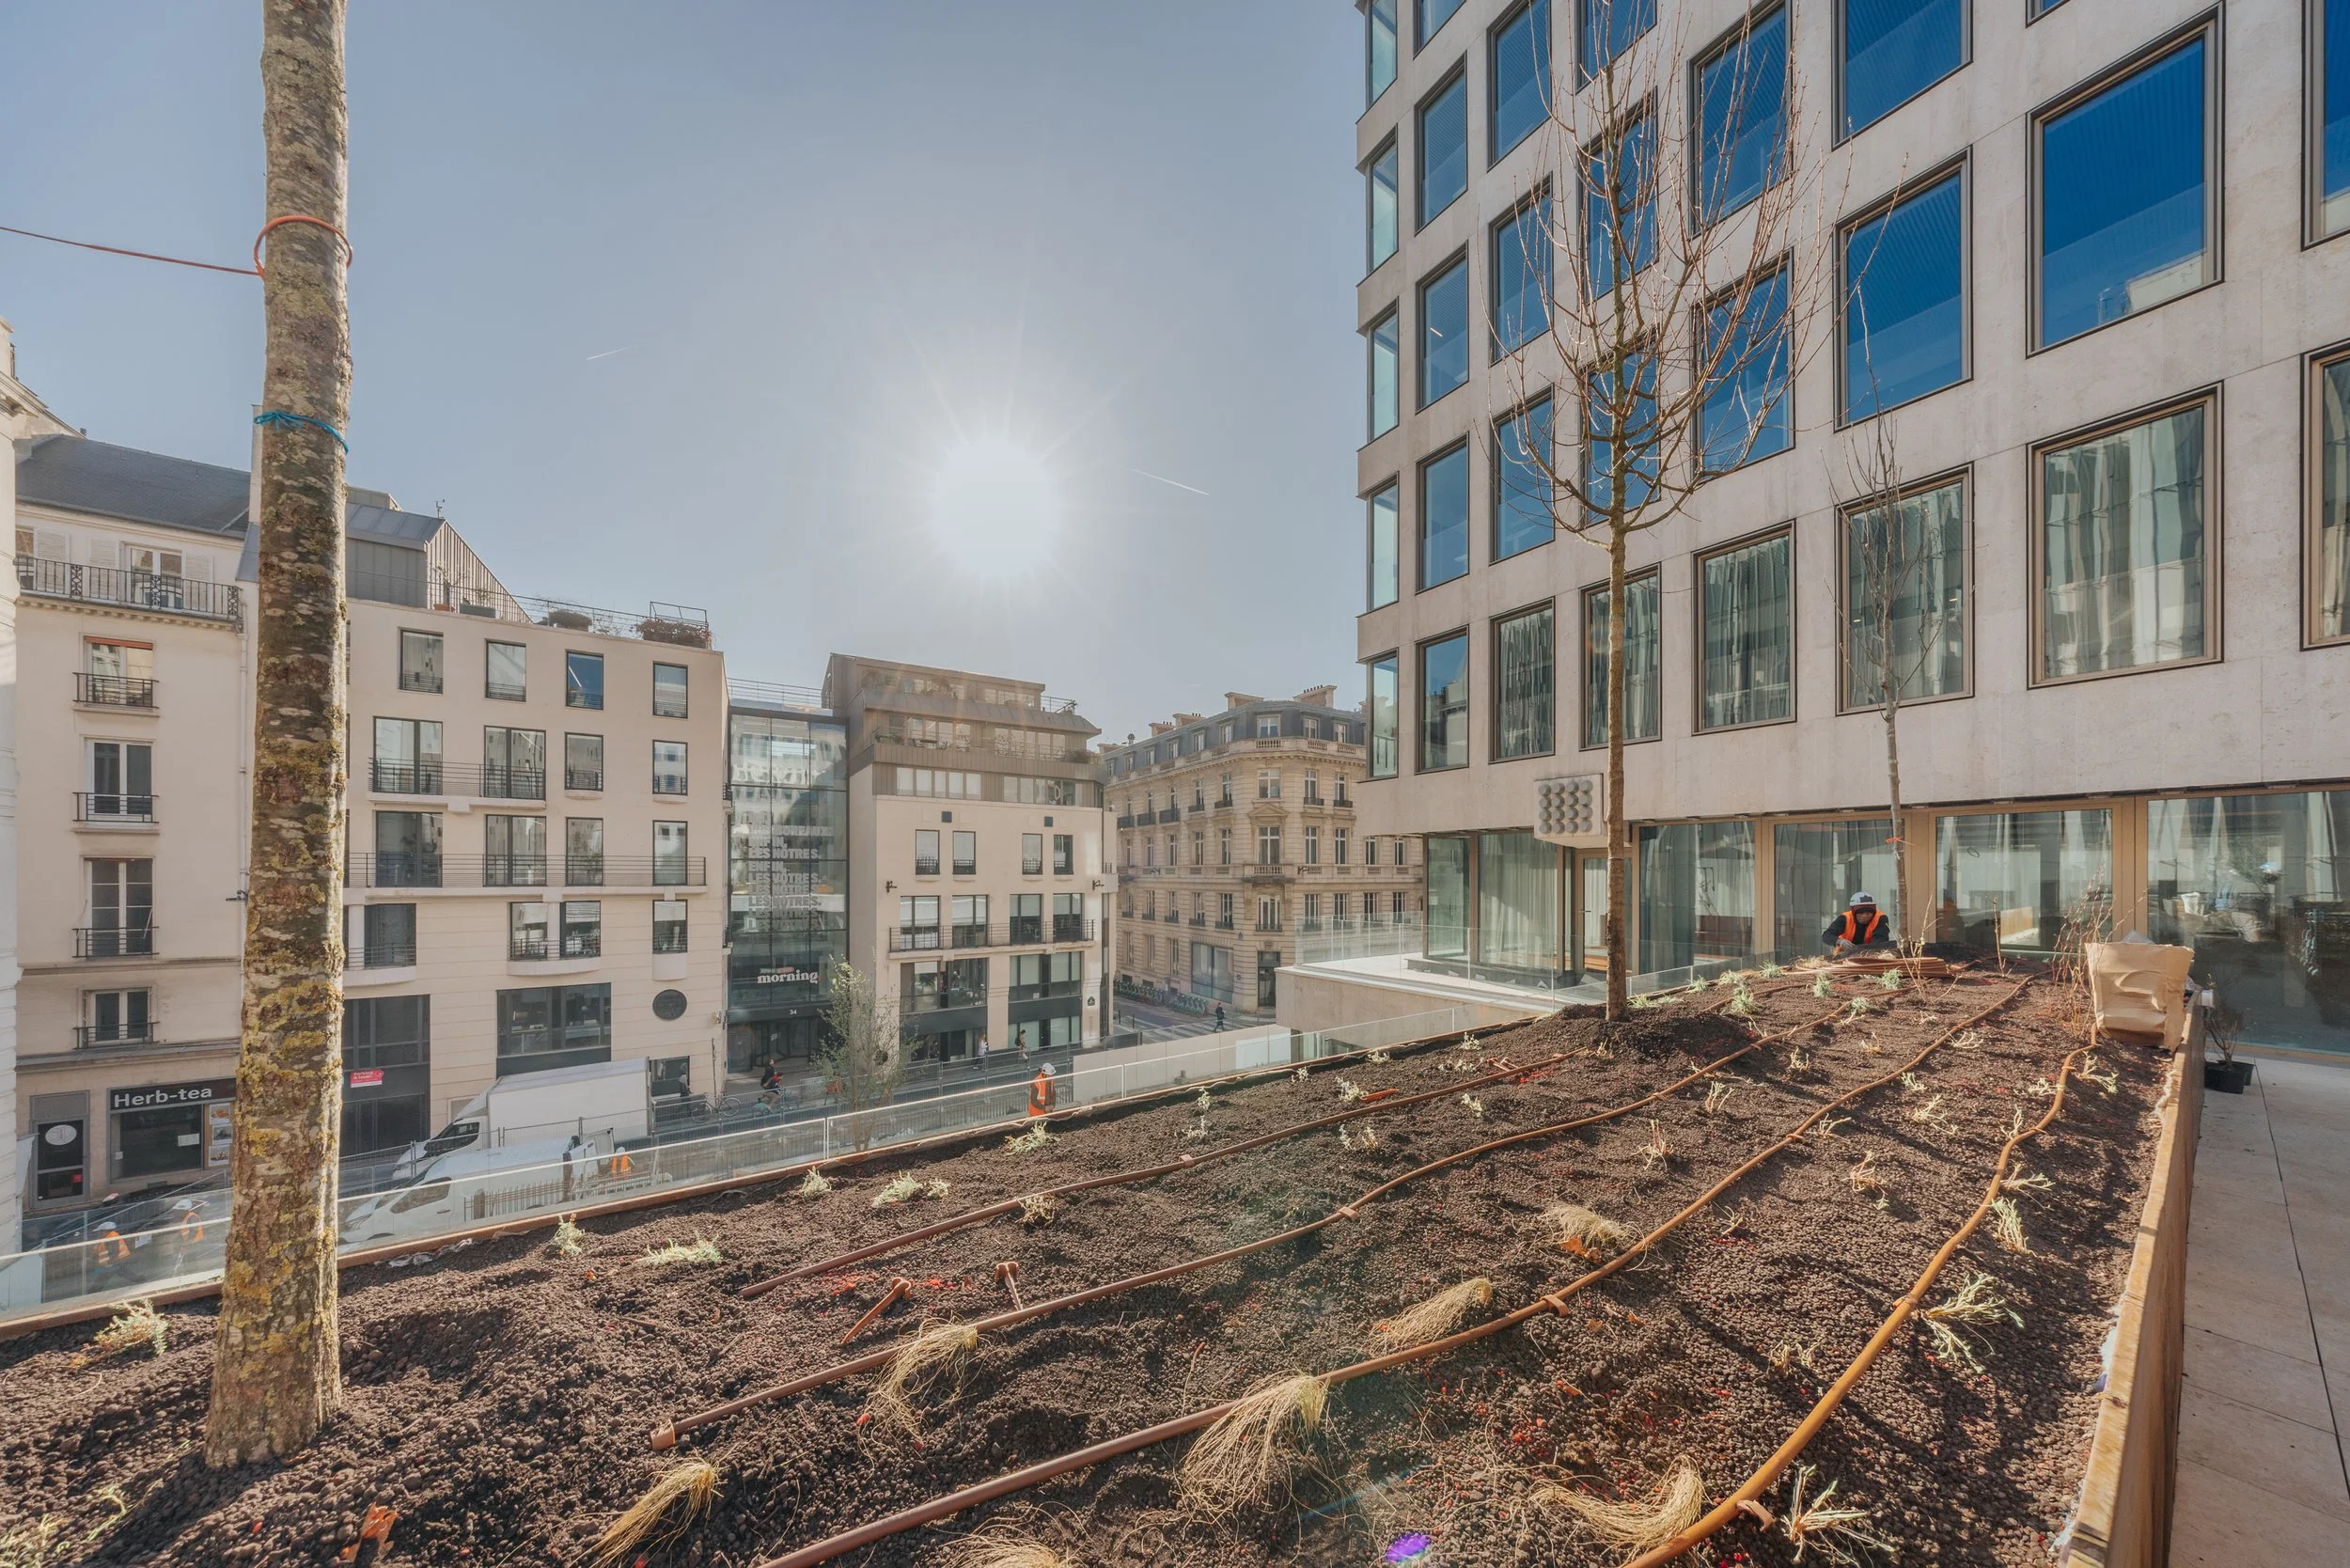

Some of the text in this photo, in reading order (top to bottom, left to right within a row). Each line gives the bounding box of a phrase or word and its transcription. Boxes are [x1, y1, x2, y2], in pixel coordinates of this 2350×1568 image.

[748, 872, 771, 883] LES
[748, 896, 771, 906] LES
[757, 969, 819, 984] morning
[114, 1088, 212, 1108] Herb-tea
